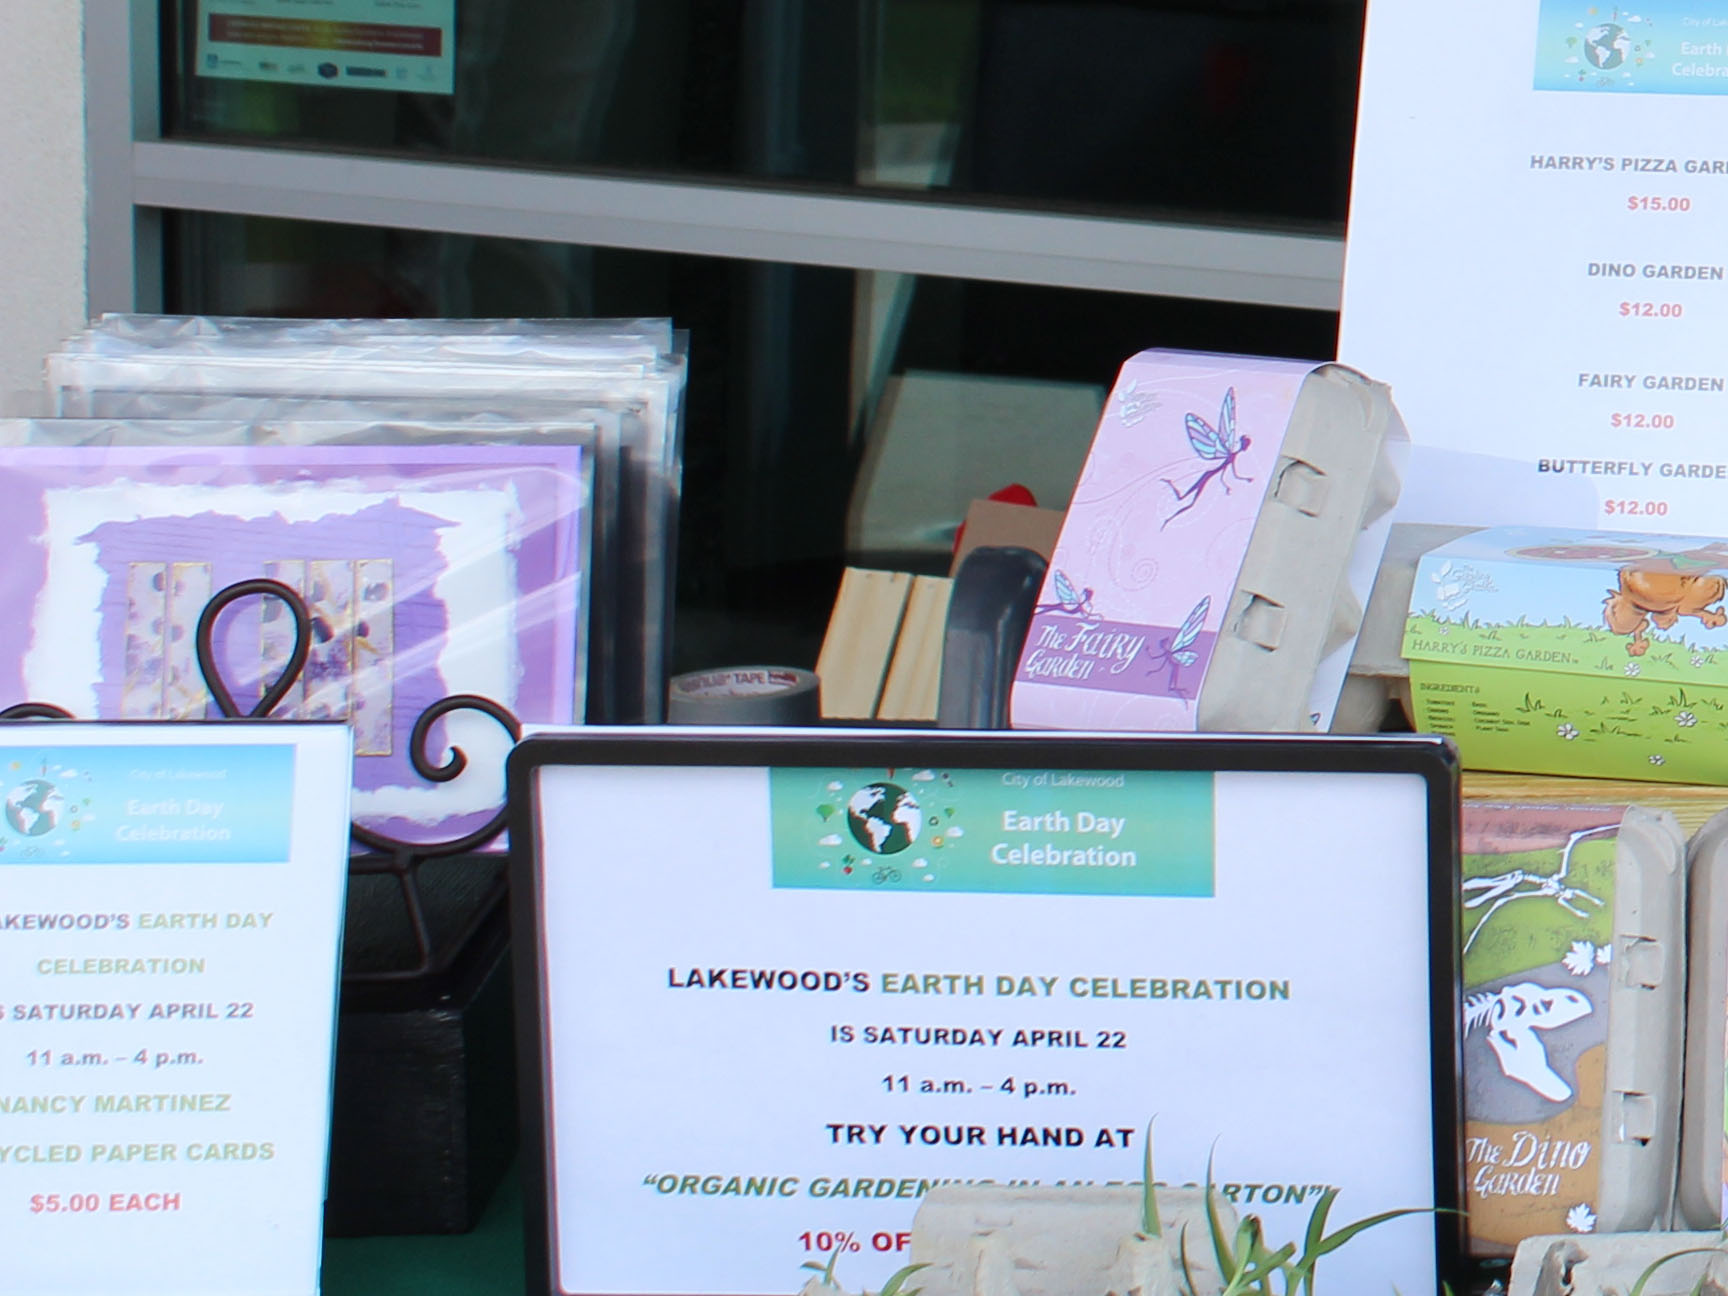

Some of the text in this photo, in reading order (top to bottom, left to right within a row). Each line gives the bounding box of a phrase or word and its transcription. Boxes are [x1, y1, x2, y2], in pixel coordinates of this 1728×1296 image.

[1680, 40, 1723, 58] Earth
[1530, 154, 1616, 172] HARRY'S
[1621, 157, 1677, 173] PIZZA
[1627, 195, 1691, 213] $15.00
[1587, 262, 1724, 280] DINO GARDEN
[1619, 301, 1683, 320] $12.00
[1578, 373, 1725, 392] FAIRY GARDEN
[1610, 412, 1675, 431] $12.00
[1537, 458, 1653, 478] BUTTERFLY
[1604, 499, 1669, 518] $12.00
[1036, 624, 1067, 650] The
[1472, 645, 1511, 659] PIZZA
[1516, 649, 1572, 665] GARDEN
[1002, 772, 1125, 789] City of Lakewood
[127, 799, 224, 820] Earth Day
[115, 824, 231, 843] Celebration
[1003, 810, 1126, 839] Earth Day
[991, 843, 1137, 867] Celebration
[0, 912, 274, 931] KEWOOD'S EARTH DAY
[37, 958, 206, 975] CELEBRATION
[667, 967, 1291, 1002] LAKEWOOD'S EARTH DAY CELEBRATION
[13, 1003, 141, 1021] SATURDAY
[149, 1002, 219, 1020] APRIL
[226, 1002, 253, 1018] 22
[830, 1025, 1127, 1050] IS SATURDAY APRIL 22
[27, 1049, 203, 1068] 11 a.m. 4 p.m.
[881, 1075, 1077, 1102] 11 a.m. 4 p.m.
[94, 1094, 232, 1112] MARTINEZ
[826, 1124, 1134, 1148] TRY YOUR HAND AT
[91, 1143, 177, 1162] PAPER
[187, 1142, 275, 1160] CARDS
[1466, 1130, 1592, 1170] The Dino
[30, 1193, 181, 1213] $5.00 EACH
[799, 1230, 861, 1252] 10%
